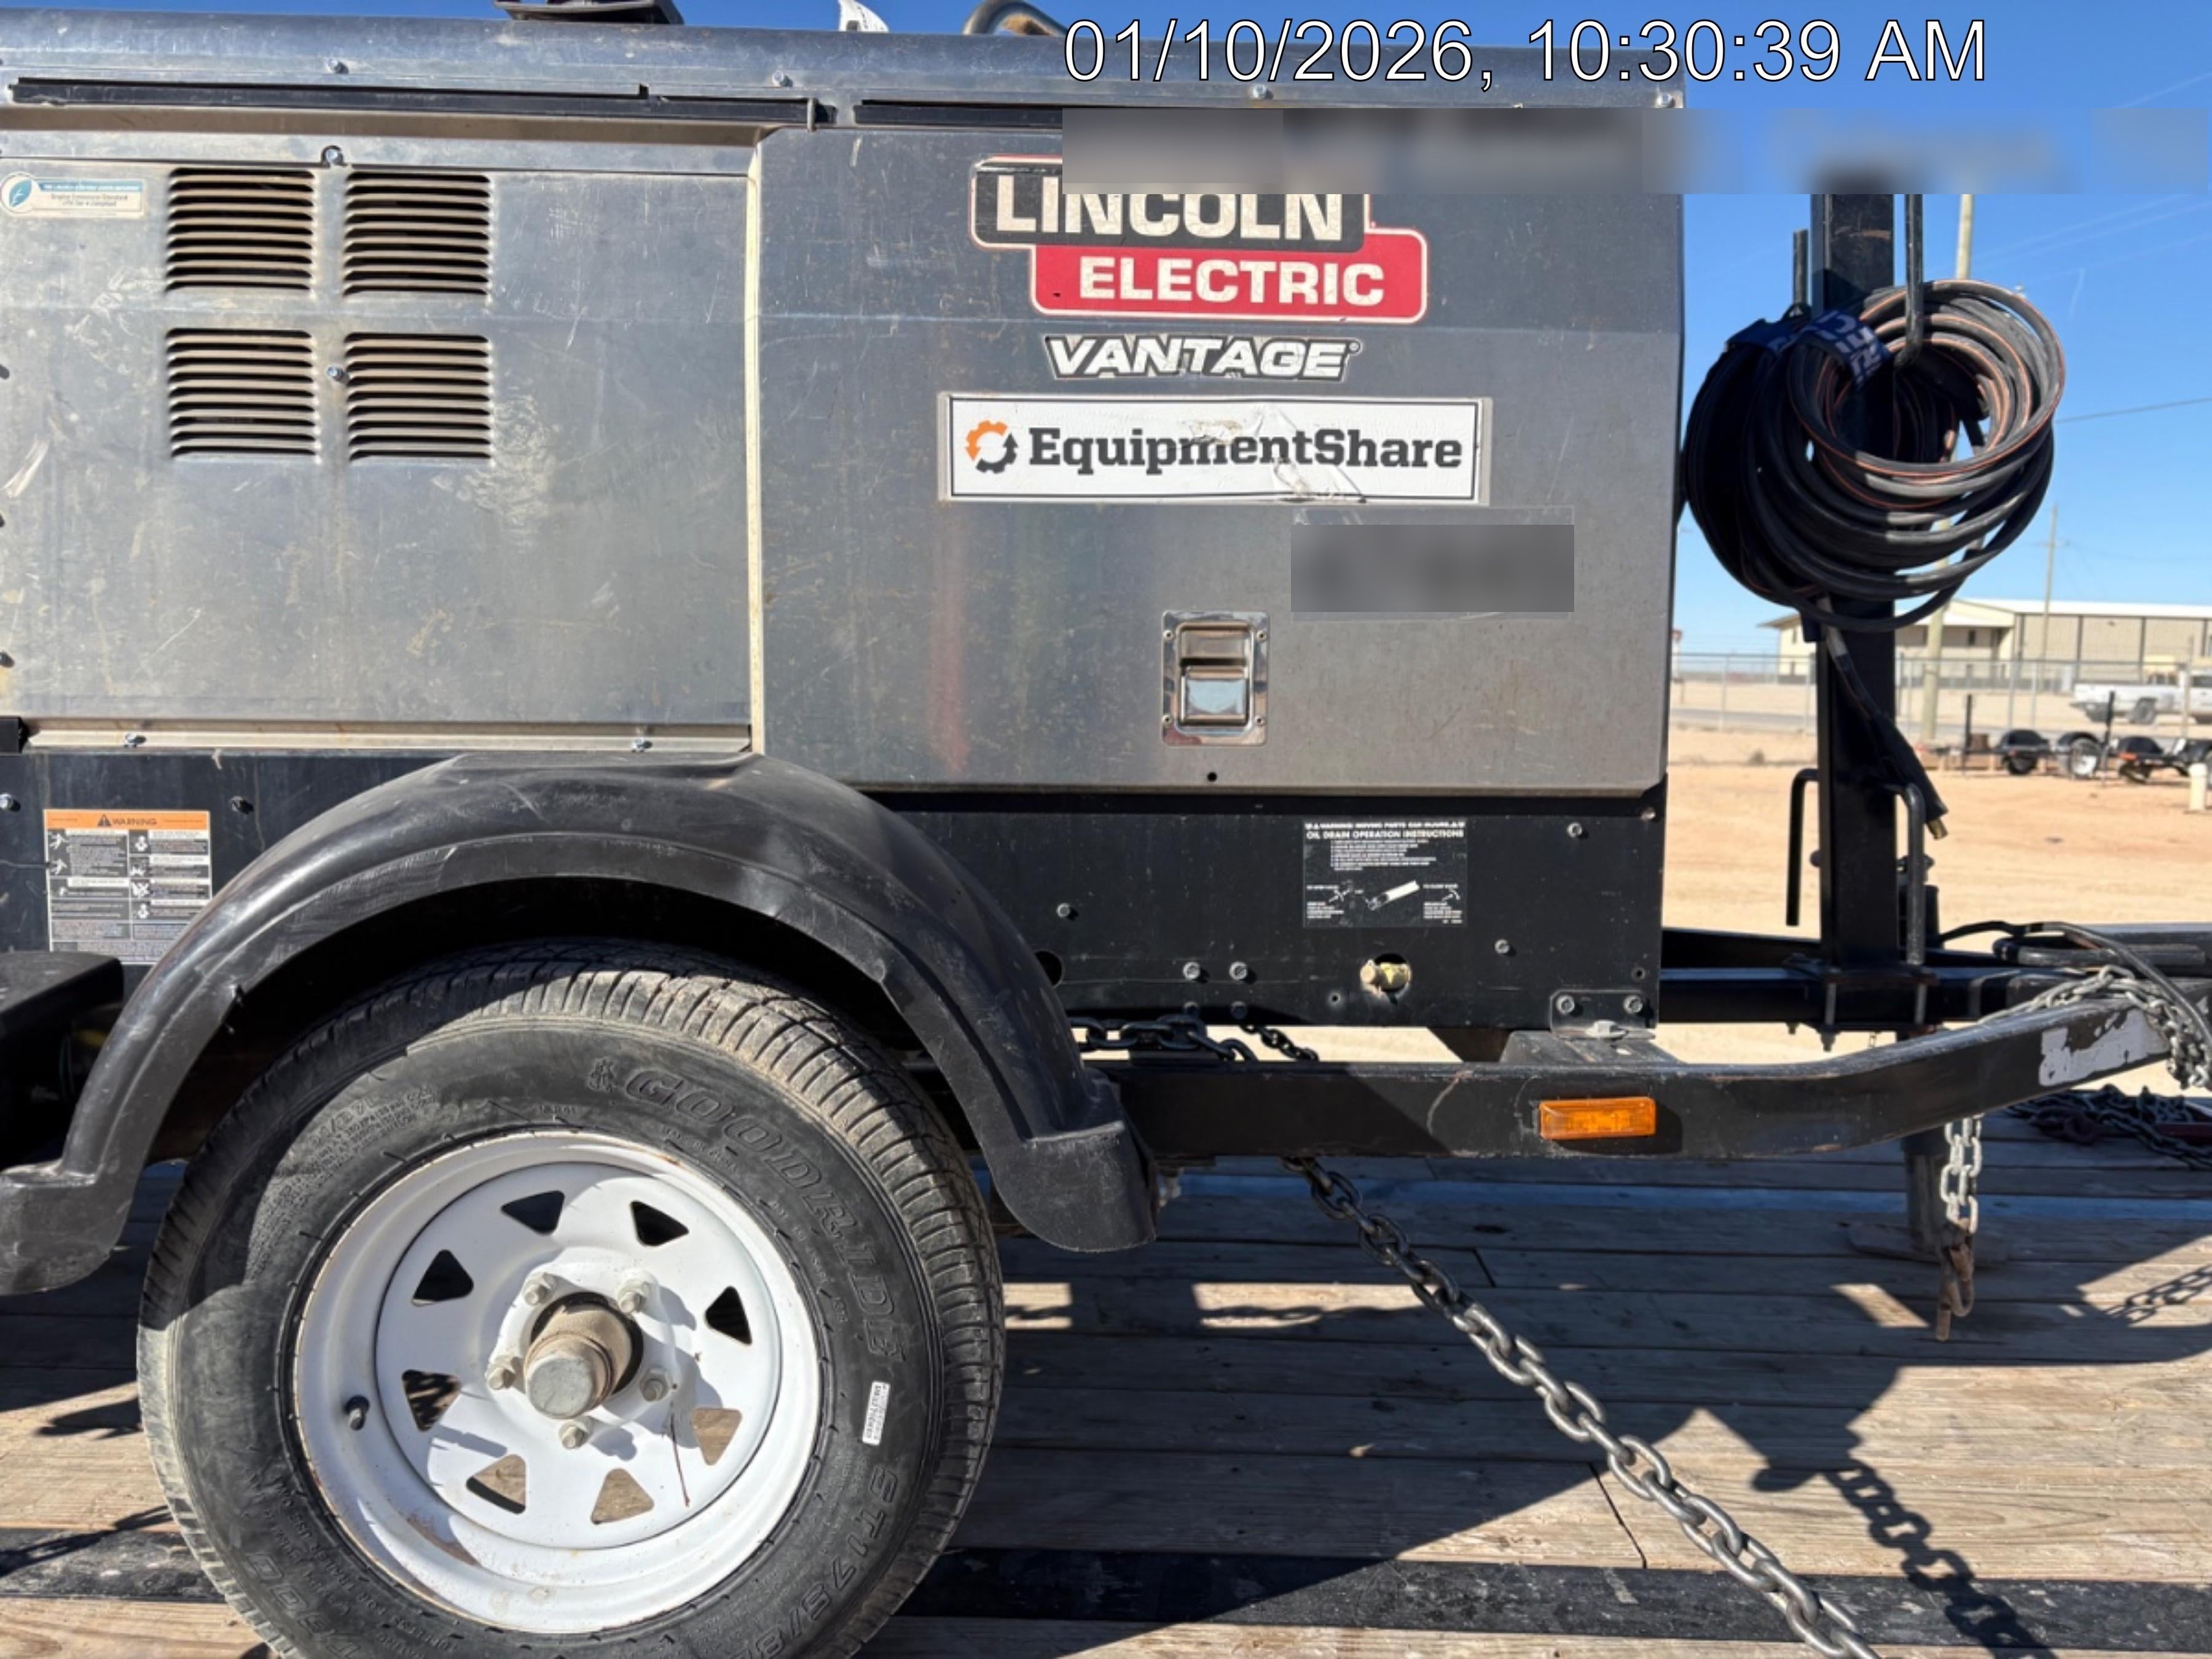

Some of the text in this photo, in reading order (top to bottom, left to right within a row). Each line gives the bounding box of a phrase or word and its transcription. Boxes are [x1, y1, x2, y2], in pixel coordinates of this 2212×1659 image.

[997, 175, 1343, 241] LINCOLN
[1079, 256, 1385, 307] ELECTRIC
[1029, 426, 1462, 475] EquipmentShare
[112, 817, 158, 826] WARNING
[1306, 830, 1464, 839] OIL DRAIN OPERATION INSTRUCTIONS
[624, 1069, 907, 1362] GOODRIDE
